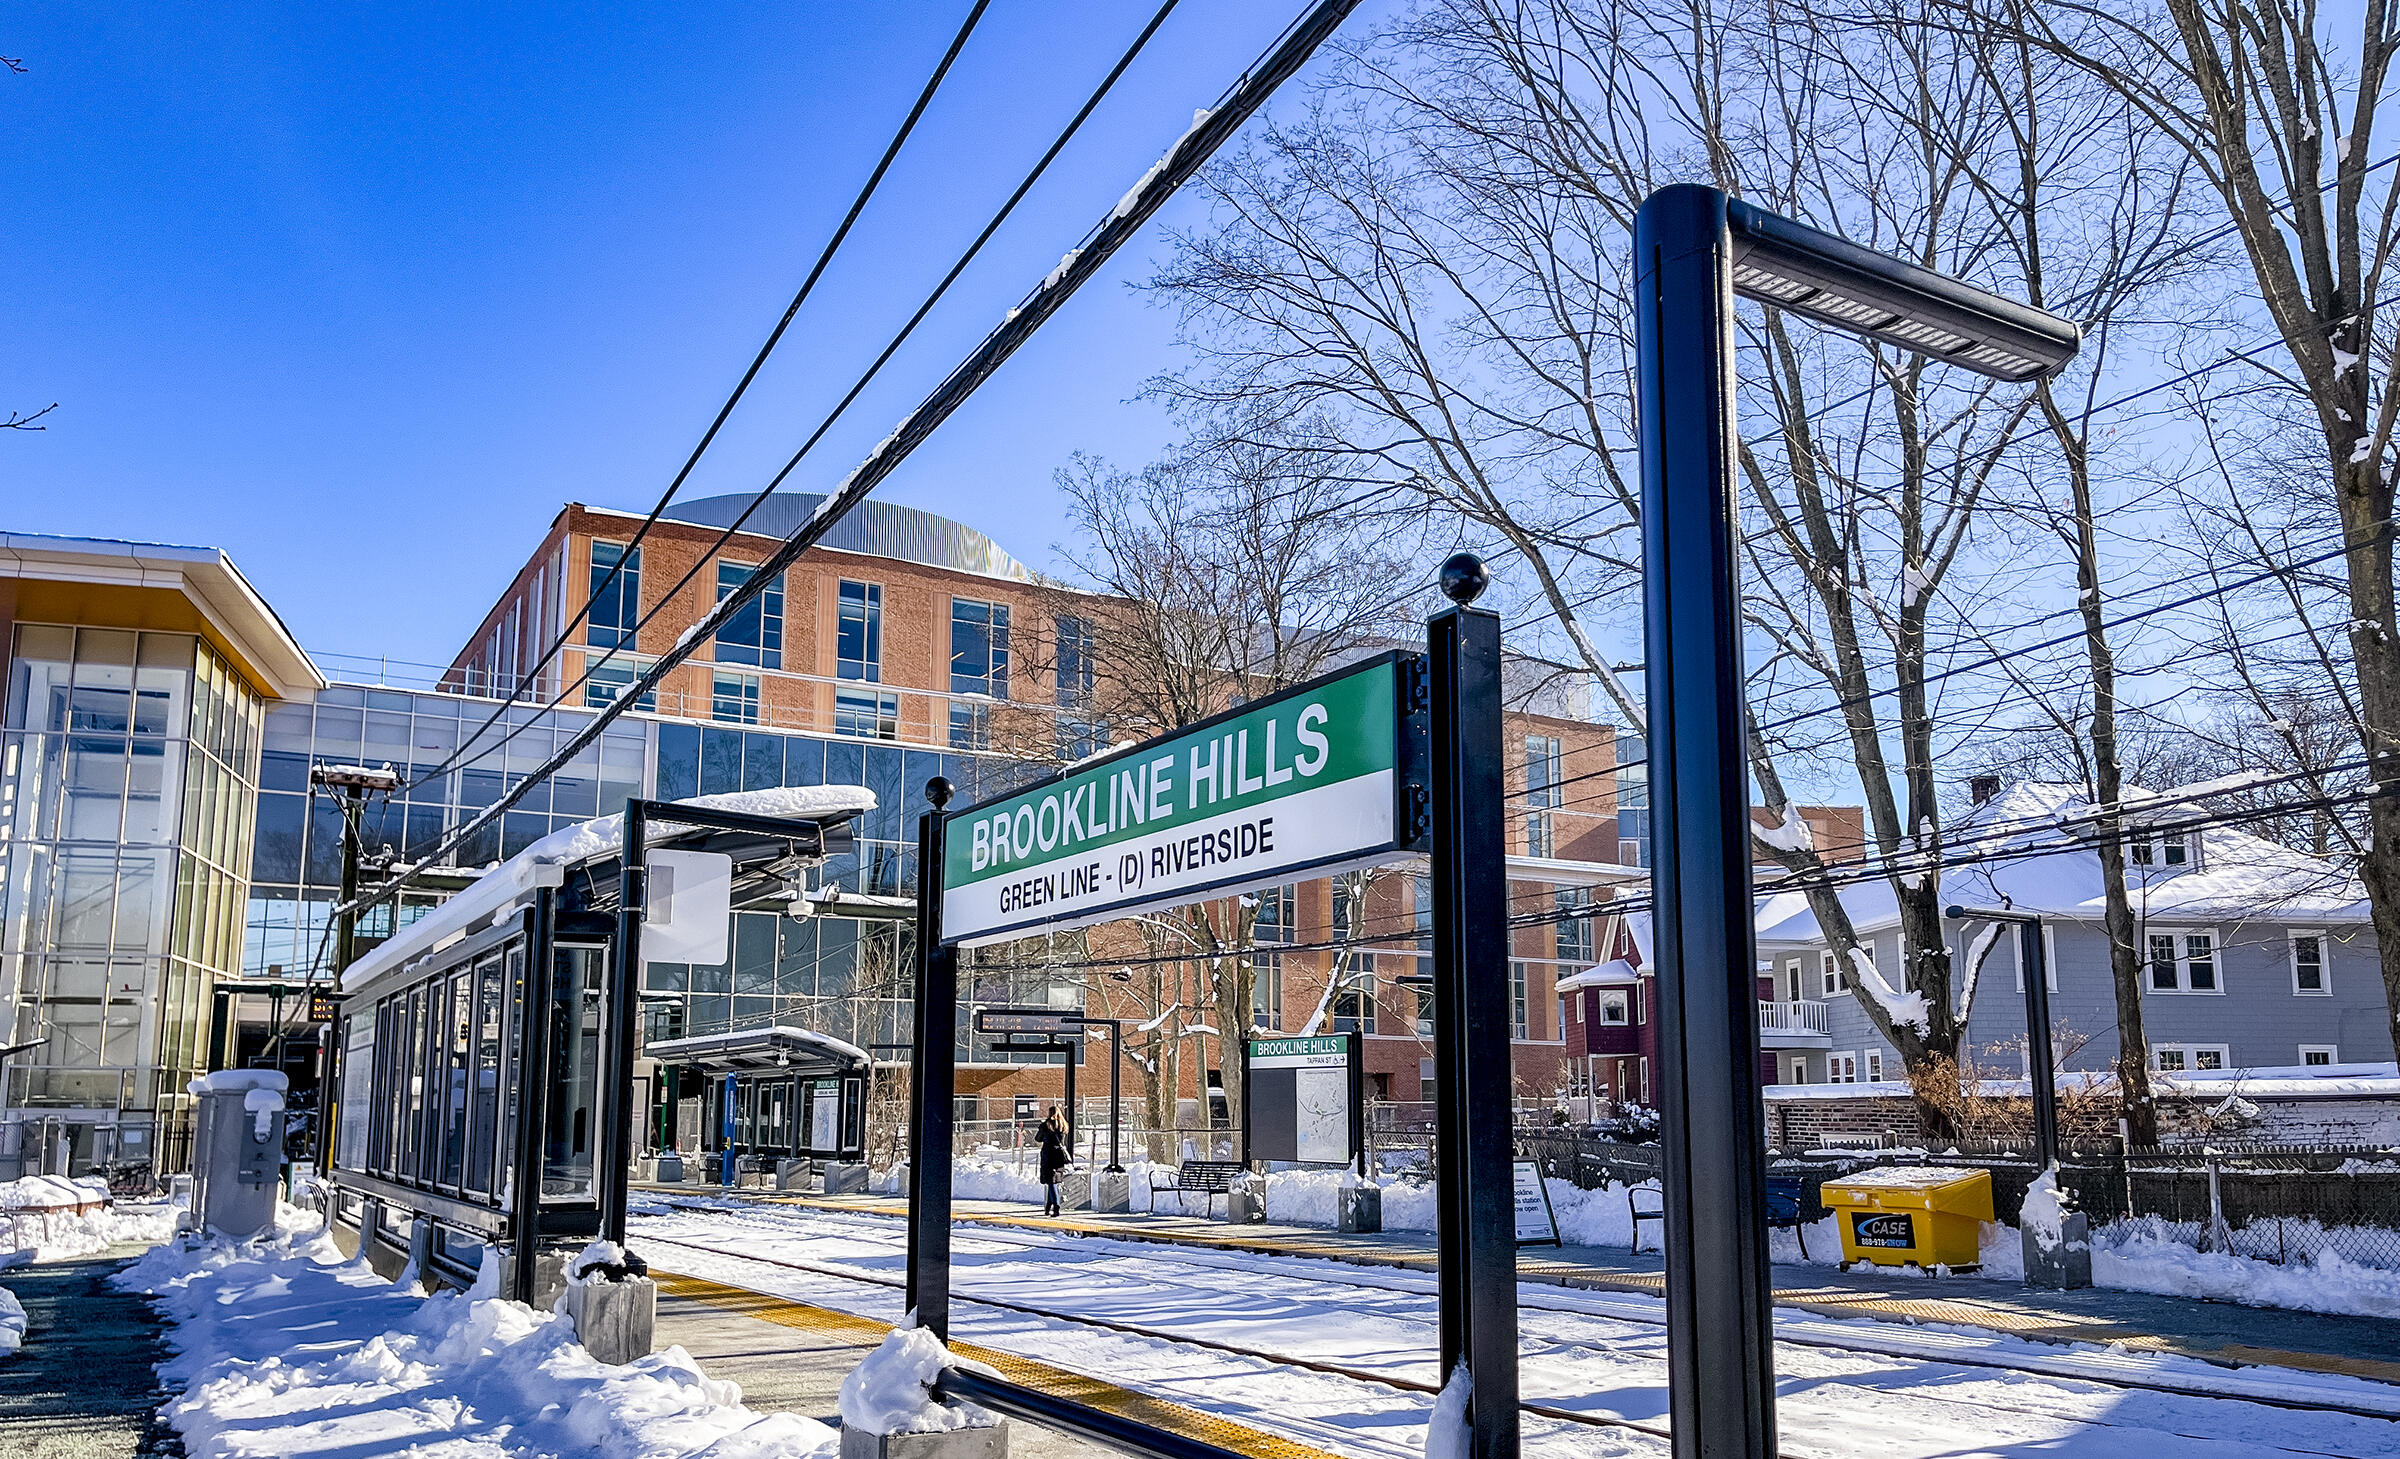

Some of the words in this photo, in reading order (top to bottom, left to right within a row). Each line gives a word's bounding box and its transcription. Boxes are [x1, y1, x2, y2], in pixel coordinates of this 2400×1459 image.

[971, 754, 1174, 873] BROOKLINE
[1189, 702, 1329, 810] HILLS
[1000, 875, 1055, 914] GREEN
[1060, 864, 1100, 900] LINE
[1118, 851, 1144, 893] (D)
[1151, 817, 1274, 879] RIVERSIDE
[1258, 1041, 1308, 1055] BROOKLINE
[1311, 1039, 1337, 1053] HILLS
[1872, 1221, 1907, 1235] CASE
